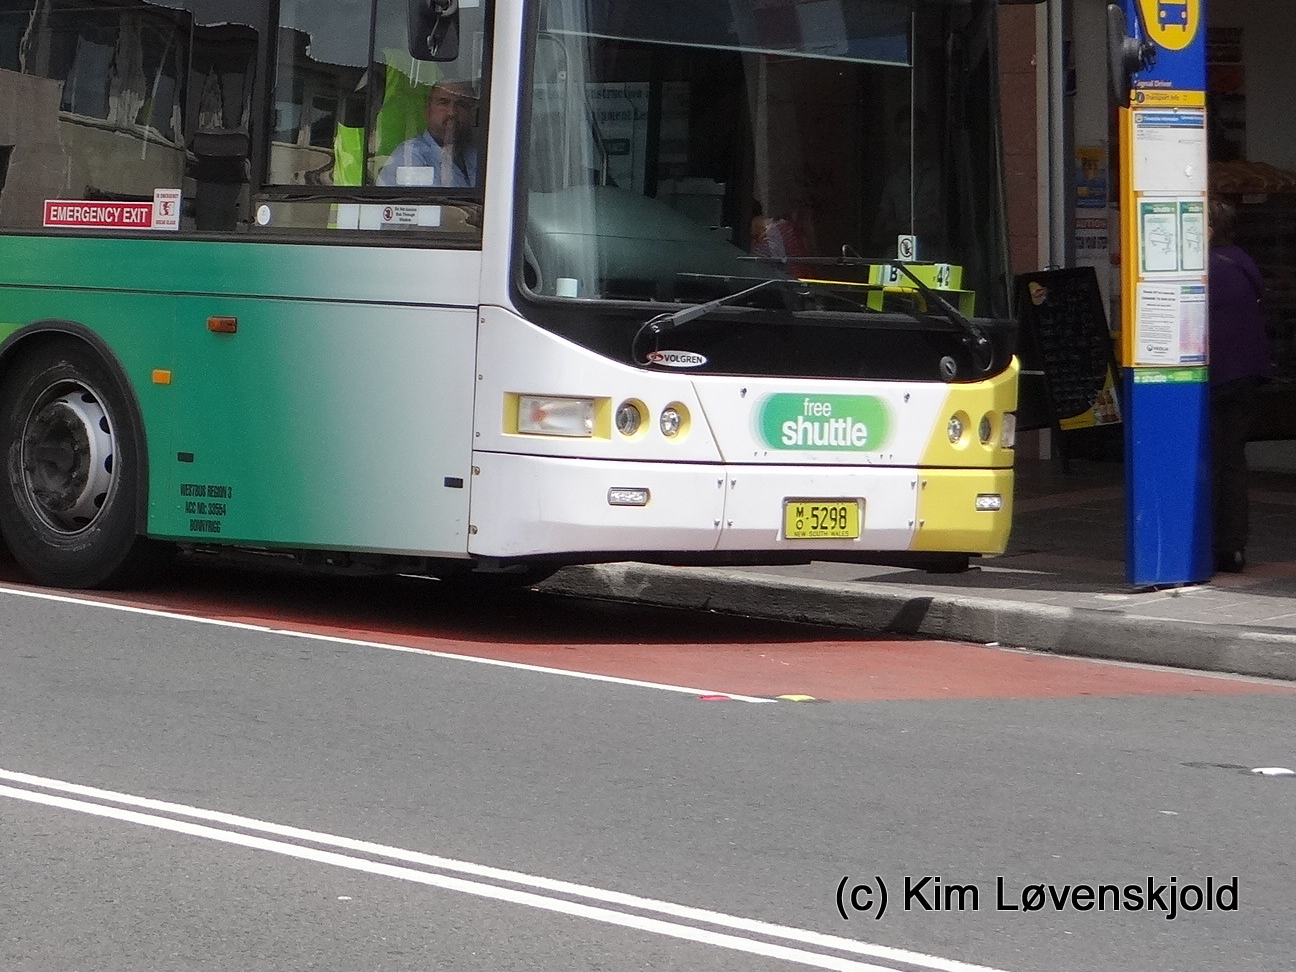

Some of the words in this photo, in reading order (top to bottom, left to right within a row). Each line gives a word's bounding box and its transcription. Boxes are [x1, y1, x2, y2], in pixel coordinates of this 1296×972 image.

[50, 205, 121, 223] EMERGENCY
[123, 207, 149, 223] EXIT
[664, 354, 703, 364] VOLGREN
[803, 397, 833, 418] free
[781, 416, 868, 447] shuttle
[811, 506, 847, 530] 5298
